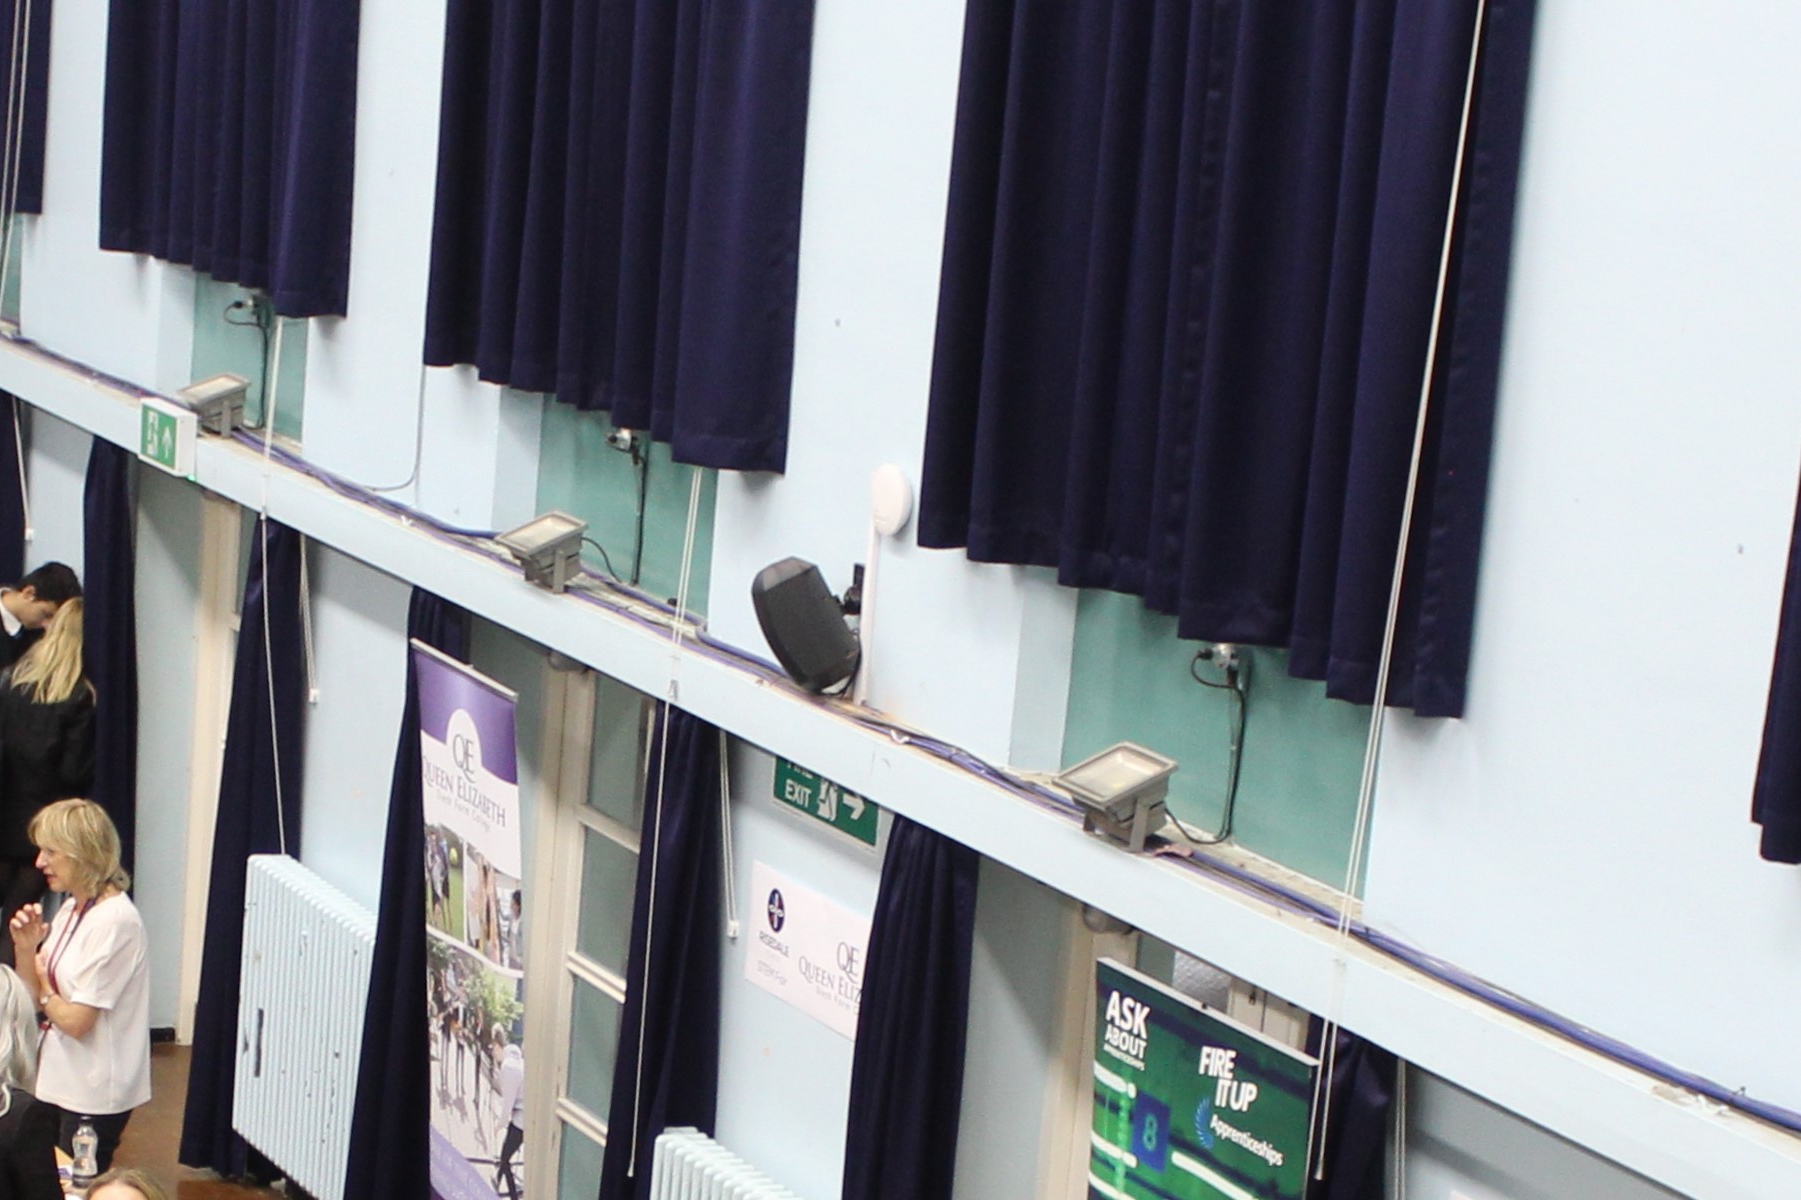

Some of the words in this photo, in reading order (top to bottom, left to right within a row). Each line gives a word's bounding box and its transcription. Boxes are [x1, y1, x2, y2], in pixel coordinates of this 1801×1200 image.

[453, 734, 475, 784] QE
[457, 775, 506, 827] ELIZABETH
[785, 779, 812, 808] EXIT
[799, 956, 835, 990] QUEEN
[838, 976, 862, 1004] ELIZ
[837, 941, 859, 984] QE
[1105, 990, 1151, 1040] ASK
[1104, 1023, 1147, 1059] ABOUT
[1198, 1045, 1237, 1080] FIRE
[1210, 1113, 1284, 1167] Apprenticeships
